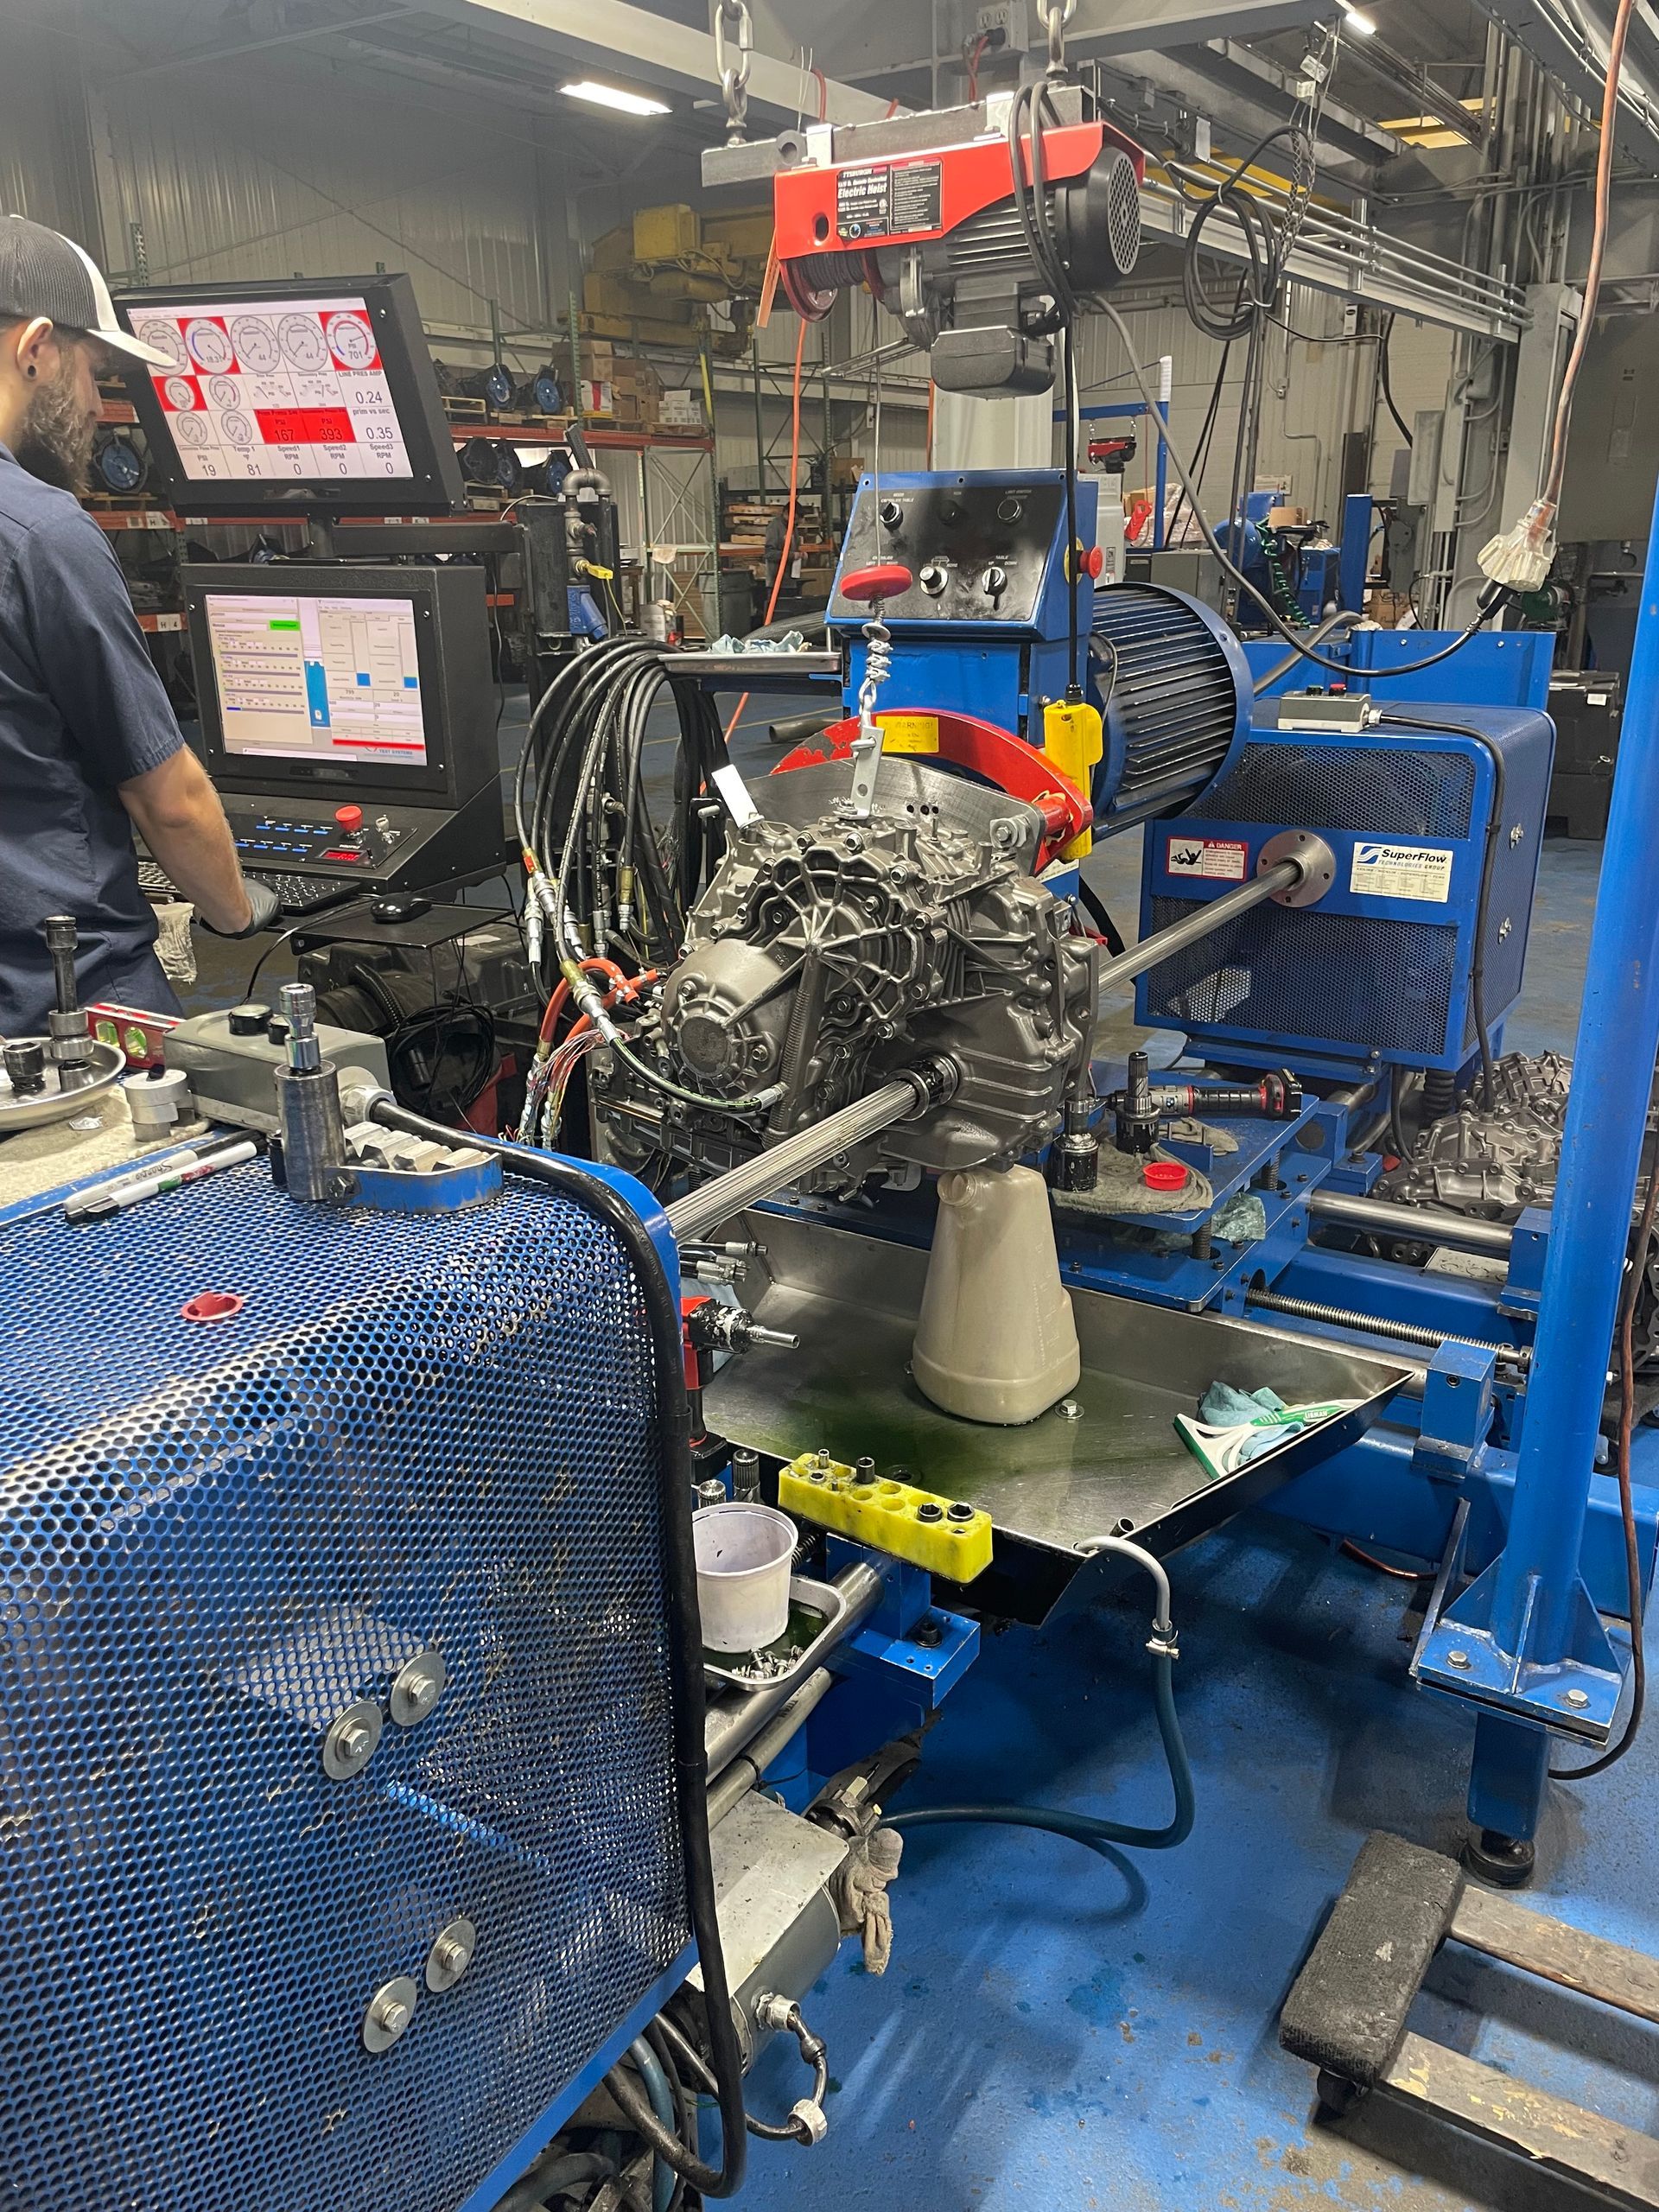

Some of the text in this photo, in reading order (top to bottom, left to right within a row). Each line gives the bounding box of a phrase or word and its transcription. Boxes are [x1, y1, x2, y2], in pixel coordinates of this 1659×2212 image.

[837, 182, 887, 199] Electric Hoist
[349, 351, 363, 359] 701
[355, 391, 383, 404] 0.24
[275, 429, 294, 442] 167
[319, 428, 342, 441] 393
[365, 427, 393, 440] 0.35
[202, 464, 217, 477] 19
[246, 464, 262, 476] 81
[294, 463, 302, 475] 0
[339, 462, 347, 474] 0
[385, 462, 394, 474] 0
[1382, 849, 1447, 863] SuperFlow
[1378, 860, 1422, 869] TECHNOLOGIES
[135, 1160, 173, 1180] Sharpie
